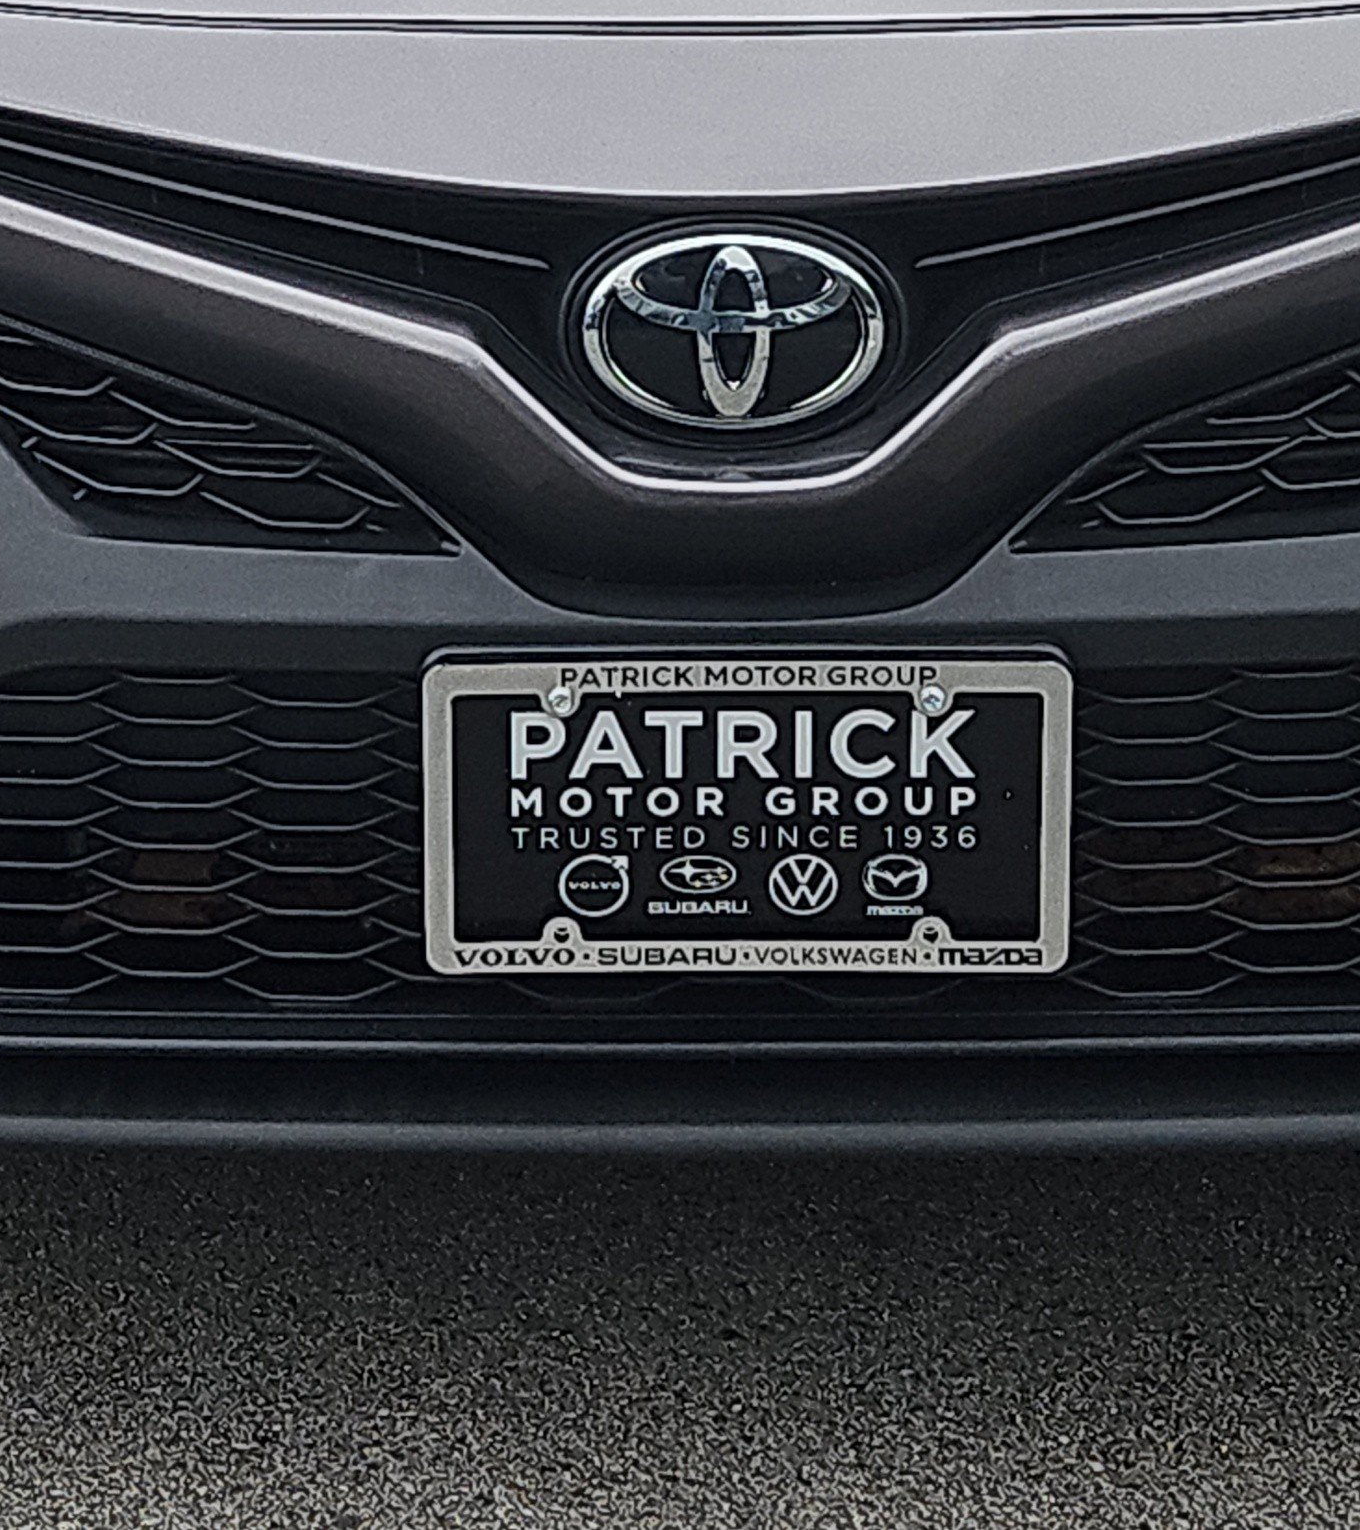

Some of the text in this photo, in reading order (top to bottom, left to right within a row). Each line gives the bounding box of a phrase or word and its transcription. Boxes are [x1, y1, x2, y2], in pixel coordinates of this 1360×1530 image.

[560, 665, 937, 689] PATRICK MOTOR GROUP
[510, 709, 976, 780] PATRICK
[510, 786, 977, 818] MOTOR GROUP
[511, 825, 977, 850] TRUSTED SINCE 1936
[567, 880, 622, 891] VOLVO
[646, 900, 748, 915] SUBARU
[454, 947, 576, 968] VOLVO
[597, 946, 737, 966] SUBARU
[753, 945, 918, 966] VOLKSWAGEN
